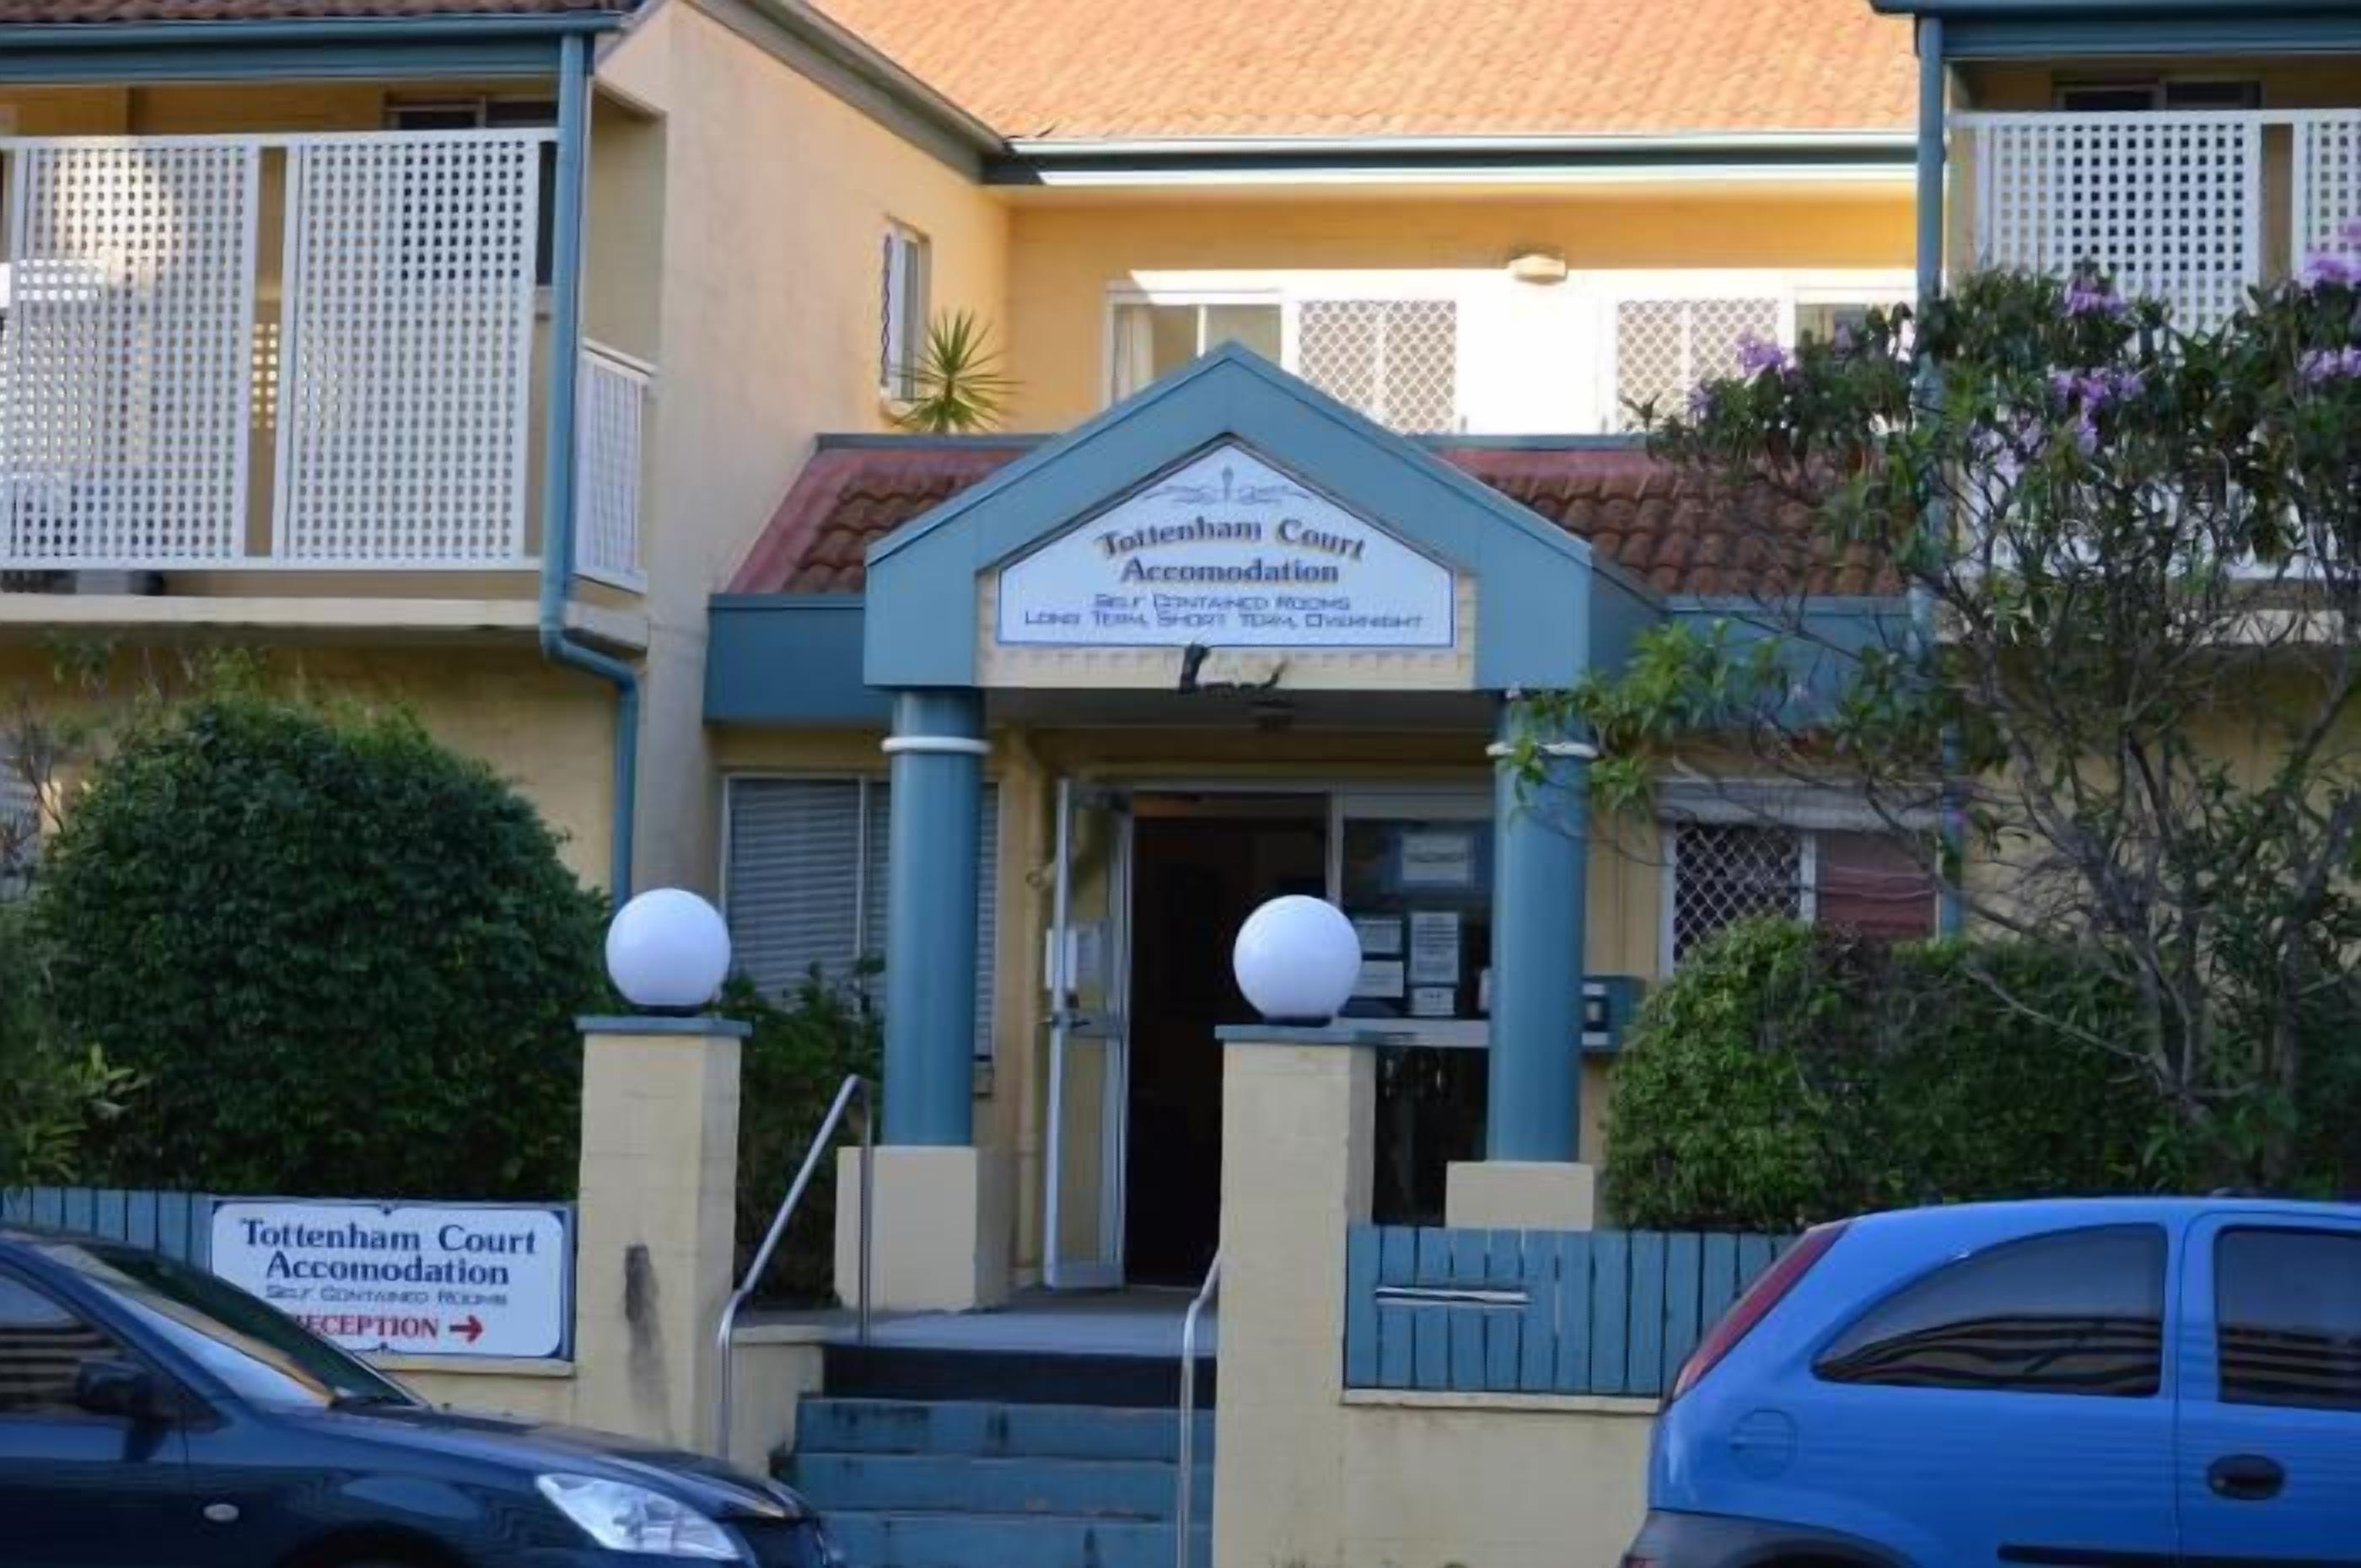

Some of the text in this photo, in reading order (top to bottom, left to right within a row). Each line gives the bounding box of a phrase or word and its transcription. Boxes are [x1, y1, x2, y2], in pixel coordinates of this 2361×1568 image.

[1097, 516, 1366, 560] Tottenham Court
[1120, 556, 1339, 583] Accomodation
[1276, 594, 1350, 610] ROOMS
[1157, 610, 1226, 627] SHORT
[239, 1216, 536, 1254] Tottenham Court
[266, 1249, 510, 1286] Accomodation
[437, 1290, 508, 1306] ROOMS
[297, 1313, 439, 1338] ECEPTION
